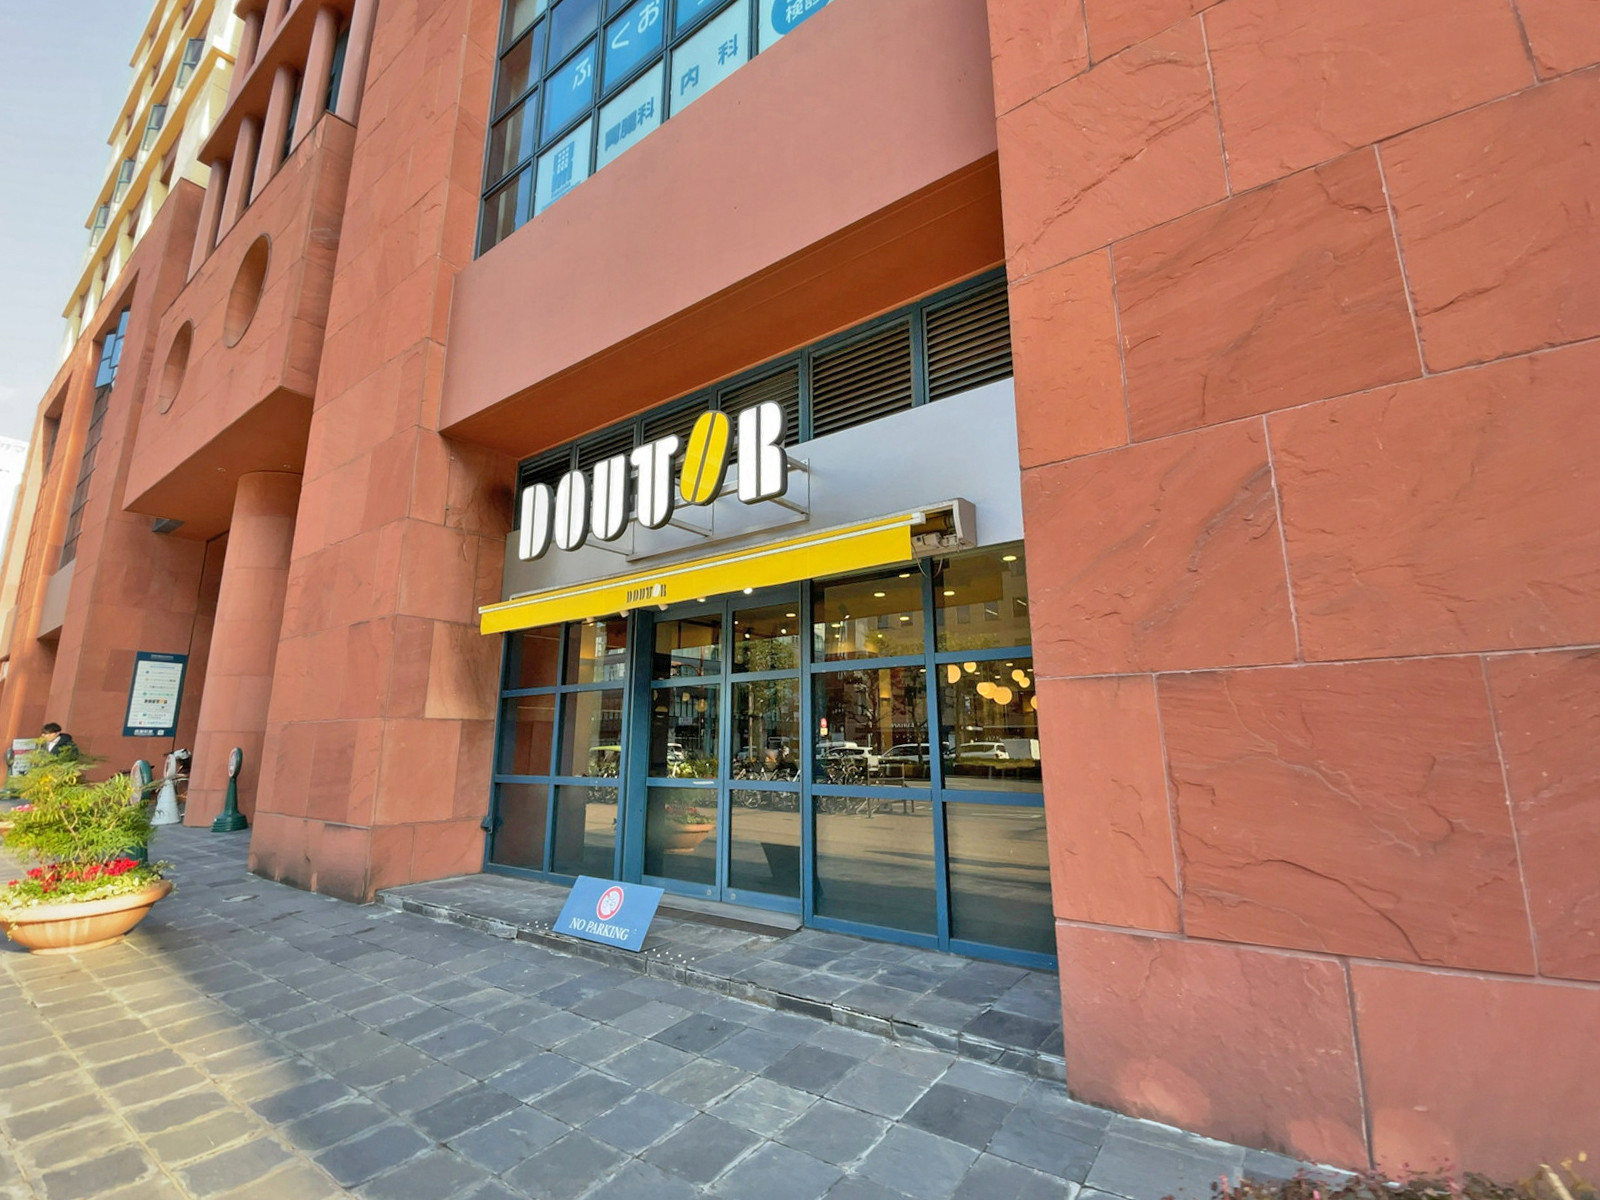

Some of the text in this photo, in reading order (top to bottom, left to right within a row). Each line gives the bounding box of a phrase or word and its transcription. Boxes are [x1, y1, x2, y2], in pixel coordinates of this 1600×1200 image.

[680, 33, 739, 96] 内科
[518, 400, 787, 562] DOUTOR
[626, 583, 667, 603] DOUTOR
[568, 917, 630, 941] NO PARKING
